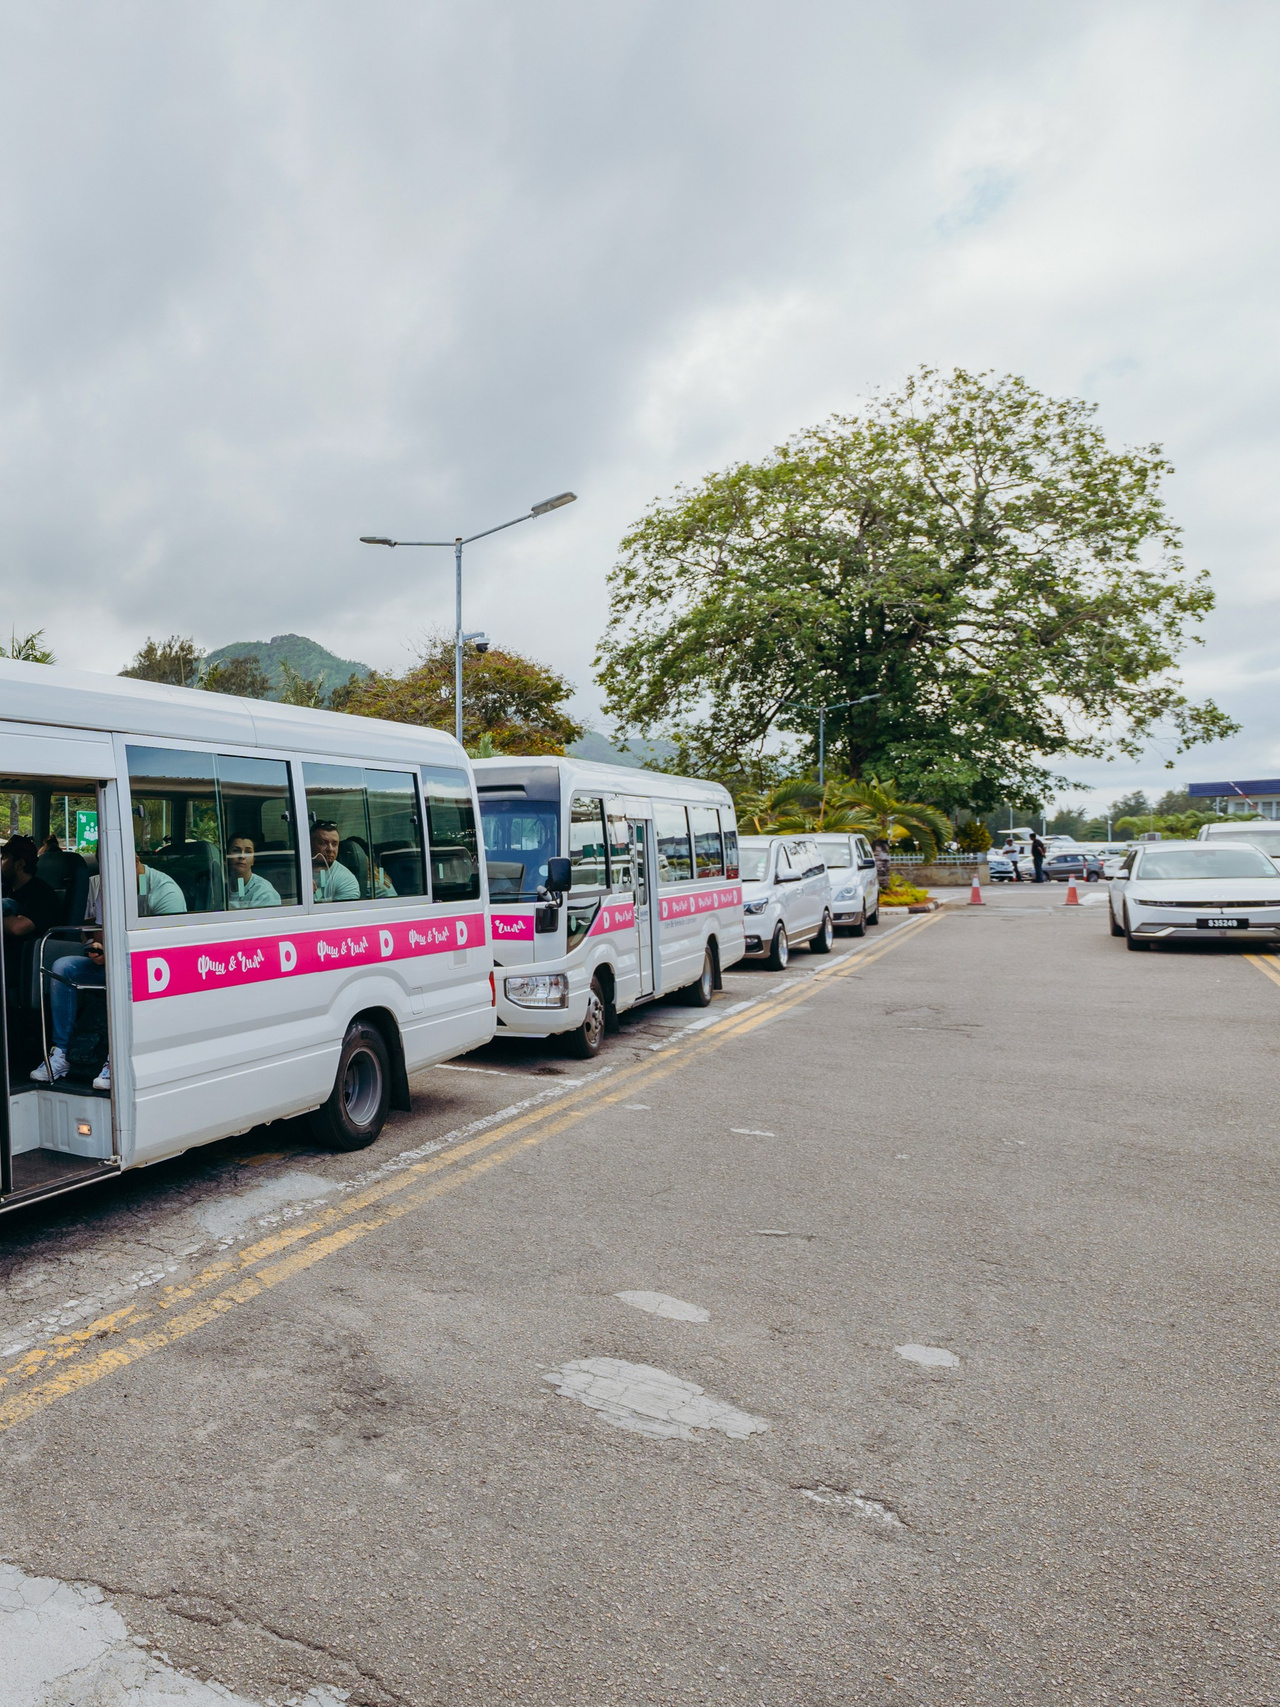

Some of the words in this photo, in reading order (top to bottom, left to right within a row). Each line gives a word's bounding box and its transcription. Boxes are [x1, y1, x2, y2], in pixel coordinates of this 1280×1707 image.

[146, 957, 171, 994] D
[228, 955, 237, 972] &
[278, 941, 298, 973] D
[340, 941, 348, 955] &
[379, 929, 394, 958] D
[455, 920, 468, 946] D
